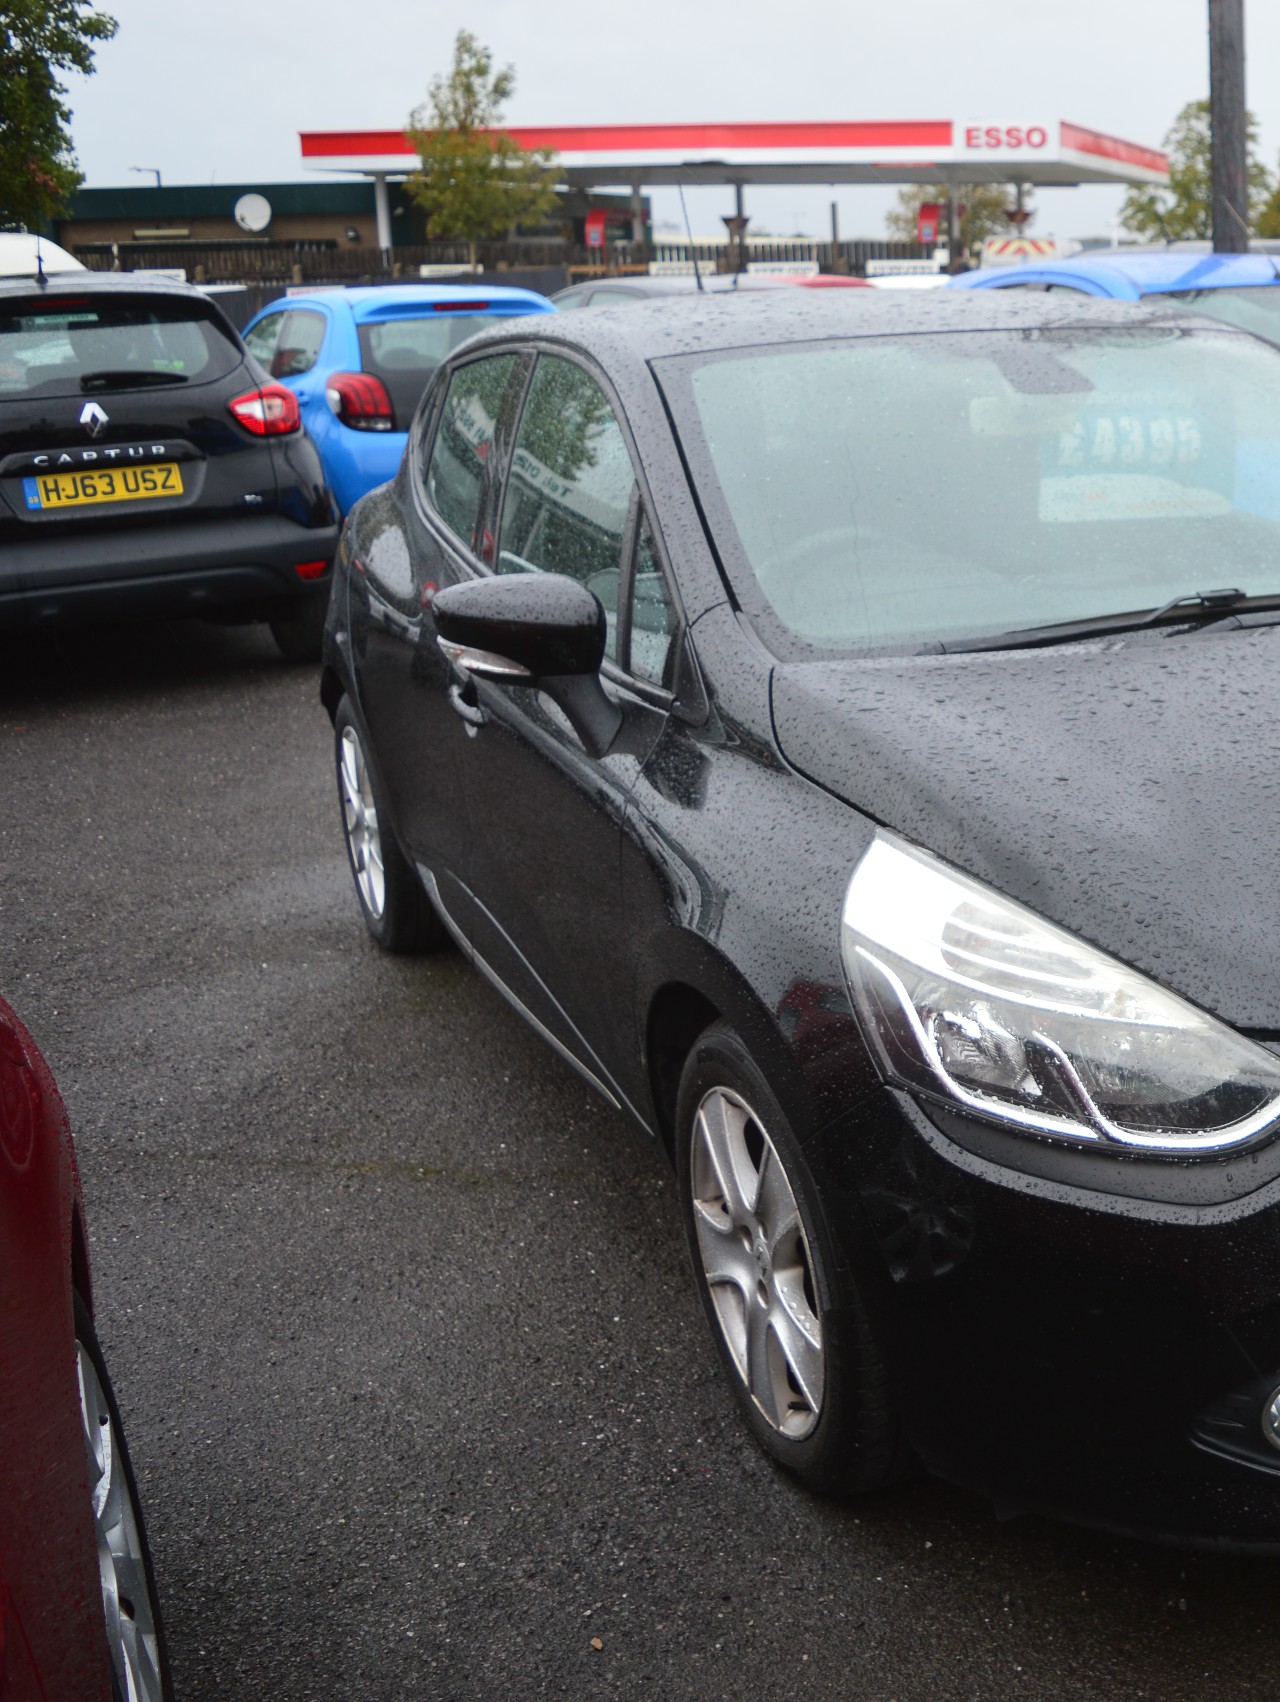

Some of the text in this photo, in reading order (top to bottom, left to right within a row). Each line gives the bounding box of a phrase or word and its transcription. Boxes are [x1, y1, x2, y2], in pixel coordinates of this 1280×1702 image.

[965, 126, 1047, 148] ESSO
[33, 445, 166, 467] CAPTUR
[43, 473, 116, 502] HJ63
